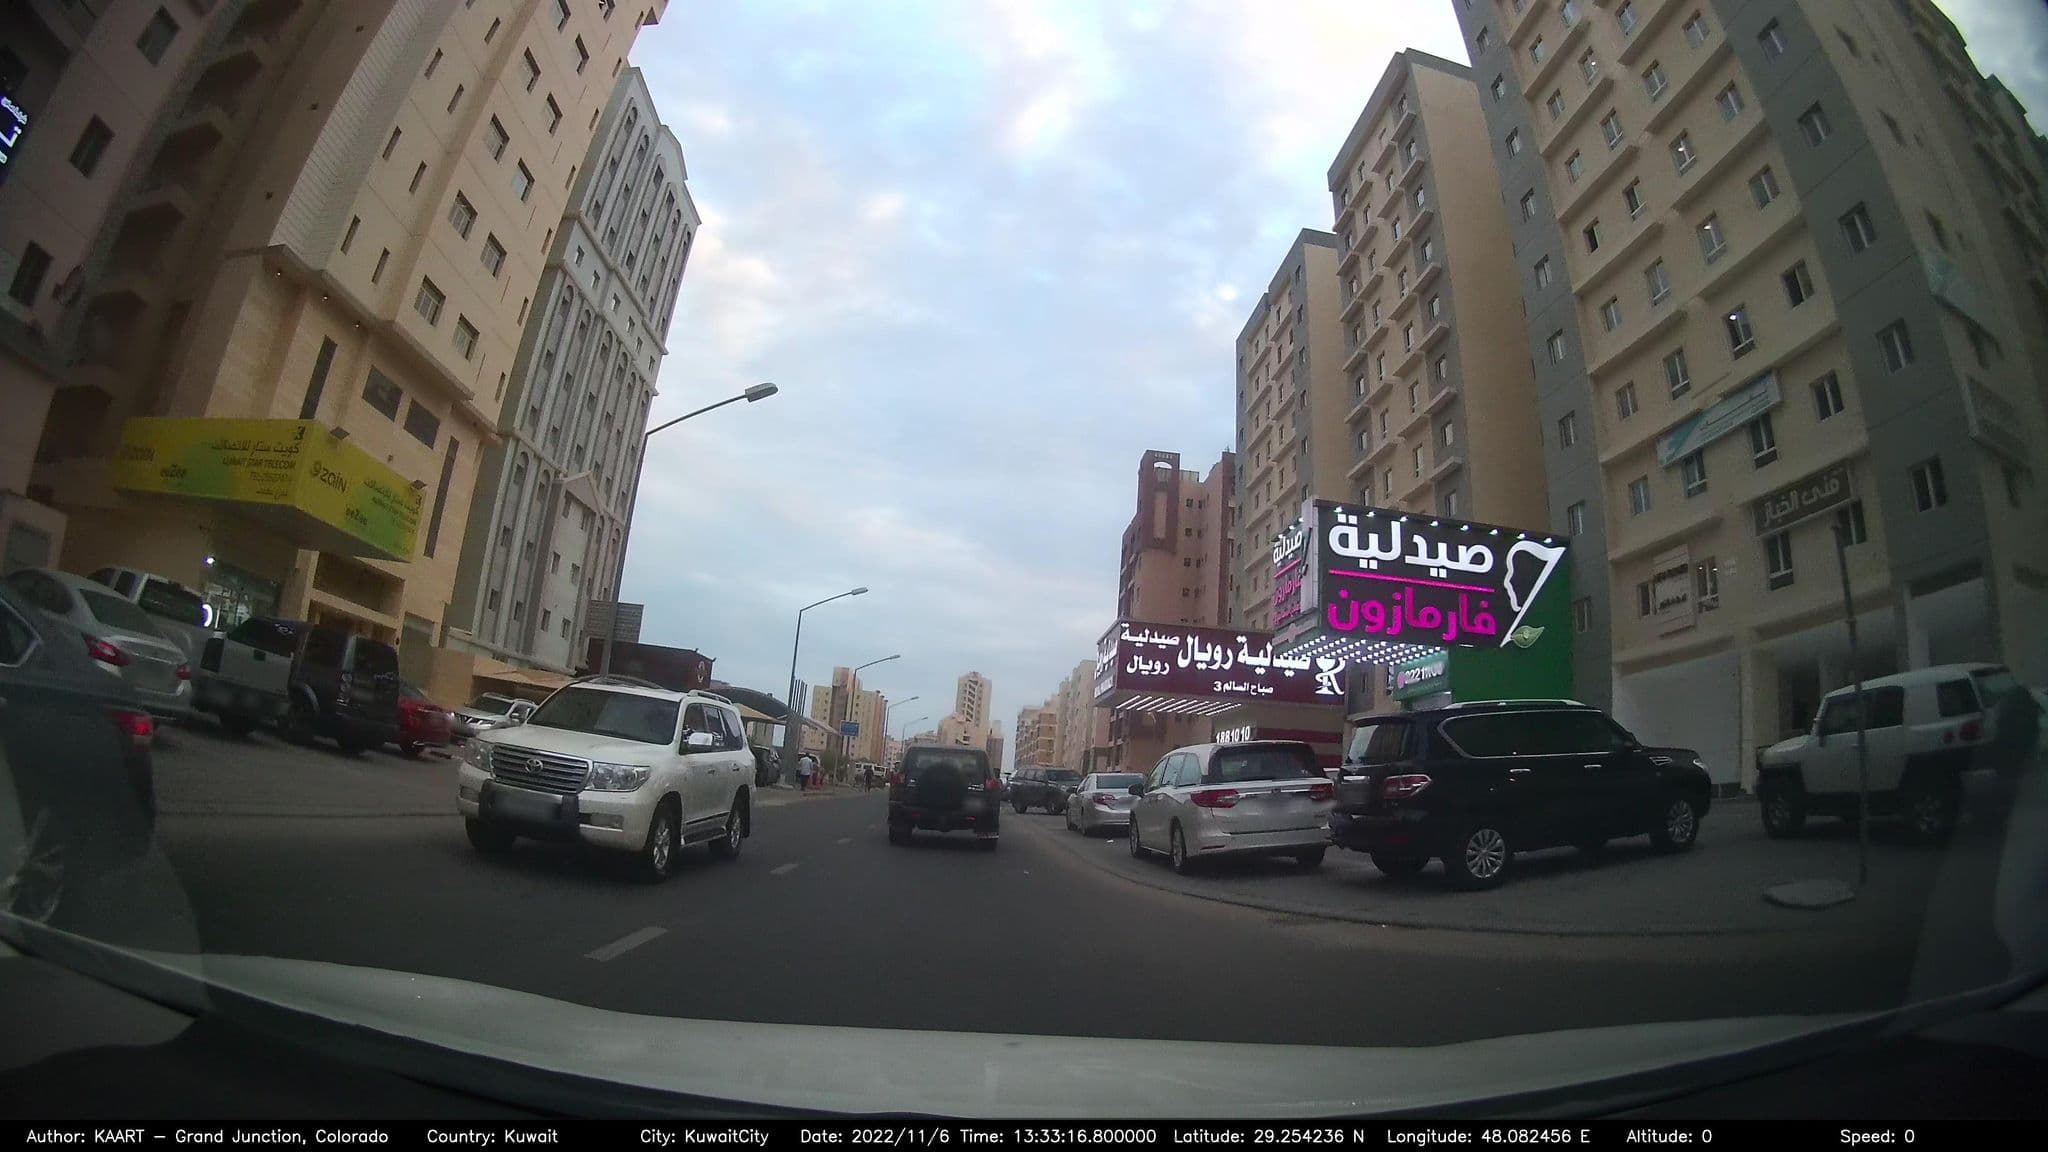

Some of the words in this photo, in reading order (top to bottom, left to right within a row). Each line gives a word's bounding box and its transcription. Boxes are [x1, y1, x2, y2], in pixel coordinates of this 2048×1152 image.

[1272, 530, 1303, 567] صيدلية
[1328, 513, 1494, 578] صيدلية
[1327, 586, 1497, 641] فارمازون
[1120, 623, 1180, 649] صيدلية
[1126, 655, 1170, 676] رويال
[1177, 635, 1233, 670] رويال
[1237, 634, 1311, 677] صيدلية
[1213, 680, 1222, 692] 3
[1223, 680, 1250, 693] السالم
[1250, 683, 1274, 696] صباح
